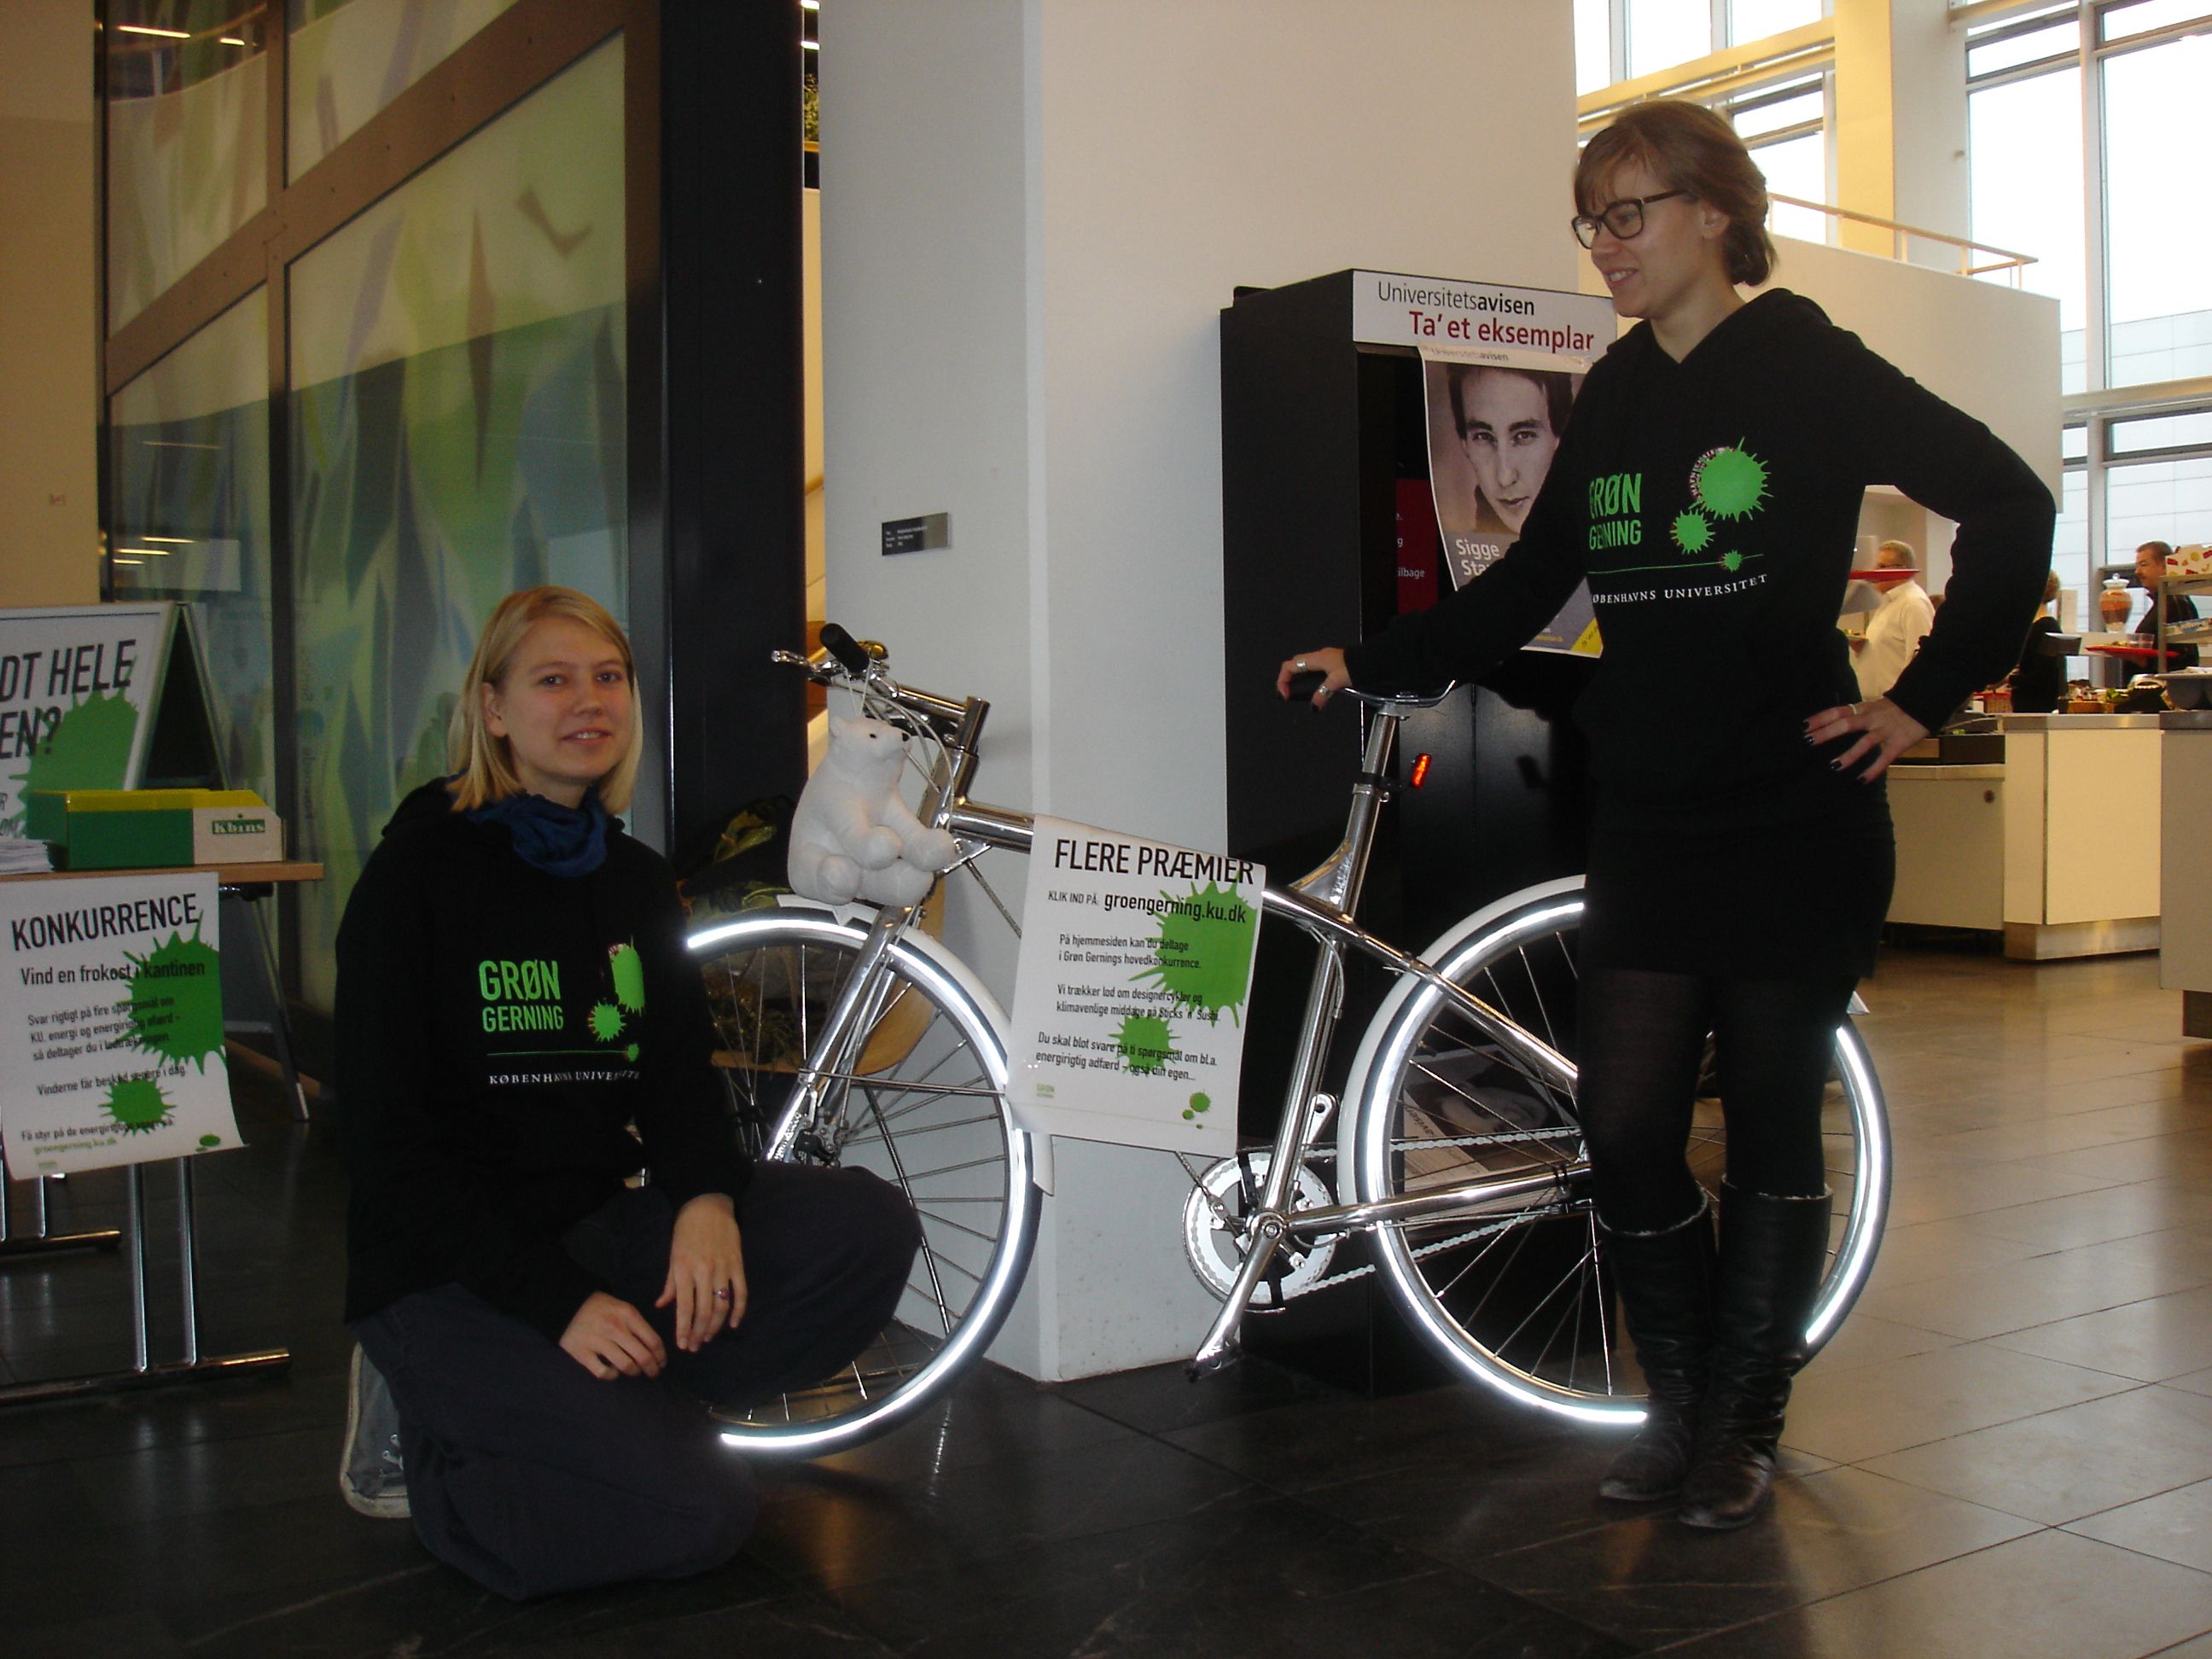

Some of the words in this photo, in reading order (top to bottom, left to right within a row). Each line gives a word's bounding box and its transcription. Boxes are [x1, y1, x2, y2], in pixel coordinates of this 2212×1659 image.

[1377, 281, 1535, 317] Universitetsavisen
[1478, 317, 1594, 354] eksemplar
[1456, 538, 1500, 562] Sigge
[1398, 567, 1425, 579] ilbage
[1461, 559, 1491, 577] Sta
[1592, 590, 1657, 604] ØBENHAVNS
[1664, 573, 1767, 599] UNIVERSITET
[48, 639, 137, 697] HELE
[1055, 838, 1132, 875] FLERE
[1137, 846, 1254, 885] PRÆMIER
[1048, 889, 1068, 902] KLIK
[1069, 892, 1085, 905] IND
[1104, 894, 1246, 923] groengerning.ku.dk
[11, 893, 201, 952] KONKURRENCE
[1059, 934, 1071, 946] På
[1073, 934, 1128, 948] hjemmesiden
[1129, 936, 1145, 948] kan
[1147, 937, 1158, 949] du
[1160, 939, 1189, 954] deltage
[1063, 950, 1084, 962] Grøn
[1086, 951, 1122, 966] Gernings
[21, 966, 53, 986] Vind
[58, 969, 76, 983] en
[80, 963, 131, 982] frokost
[144, 961, 205, 979] kantinen
[478, 958, 562, 1002] GRØN
[1057, 983, 1066, 996] Vi
[1068, 986, 1100, 998] trækker
[1103, 986, 1115, 998] lod
[1117, 989, 1131, 998] om
[27, 1014, 49, 1027] Svar
[51, 1009, 79, 1024] rigtigt
[94, 1004, 109, 1016] fire
[481, 1004, 564, 1033] GERNING
[1057, 1000, 1109, 1016] klimavenlige
[1159, 1006, 1184, 1019] Sticks
[49, 1027, 78, 1042] energi
[47, 1045, 83, 1059] deltager
[86, 1040, 97, 1053] du
[1038, 1031, 1051, 1045] Du
[1051, 1033, 1072, 1047] skal
[1073, 1034, 1090, 1050] blot
[1091, 1039, 1115, 1053] svare
[1185, 1053, 1198, 1064] om
[1035, 1051, 1087, 1070] energirigtig
[1088, 1056, 1120, 1071] adfærd
[37, 1081, 79, 1096] Vinderne
